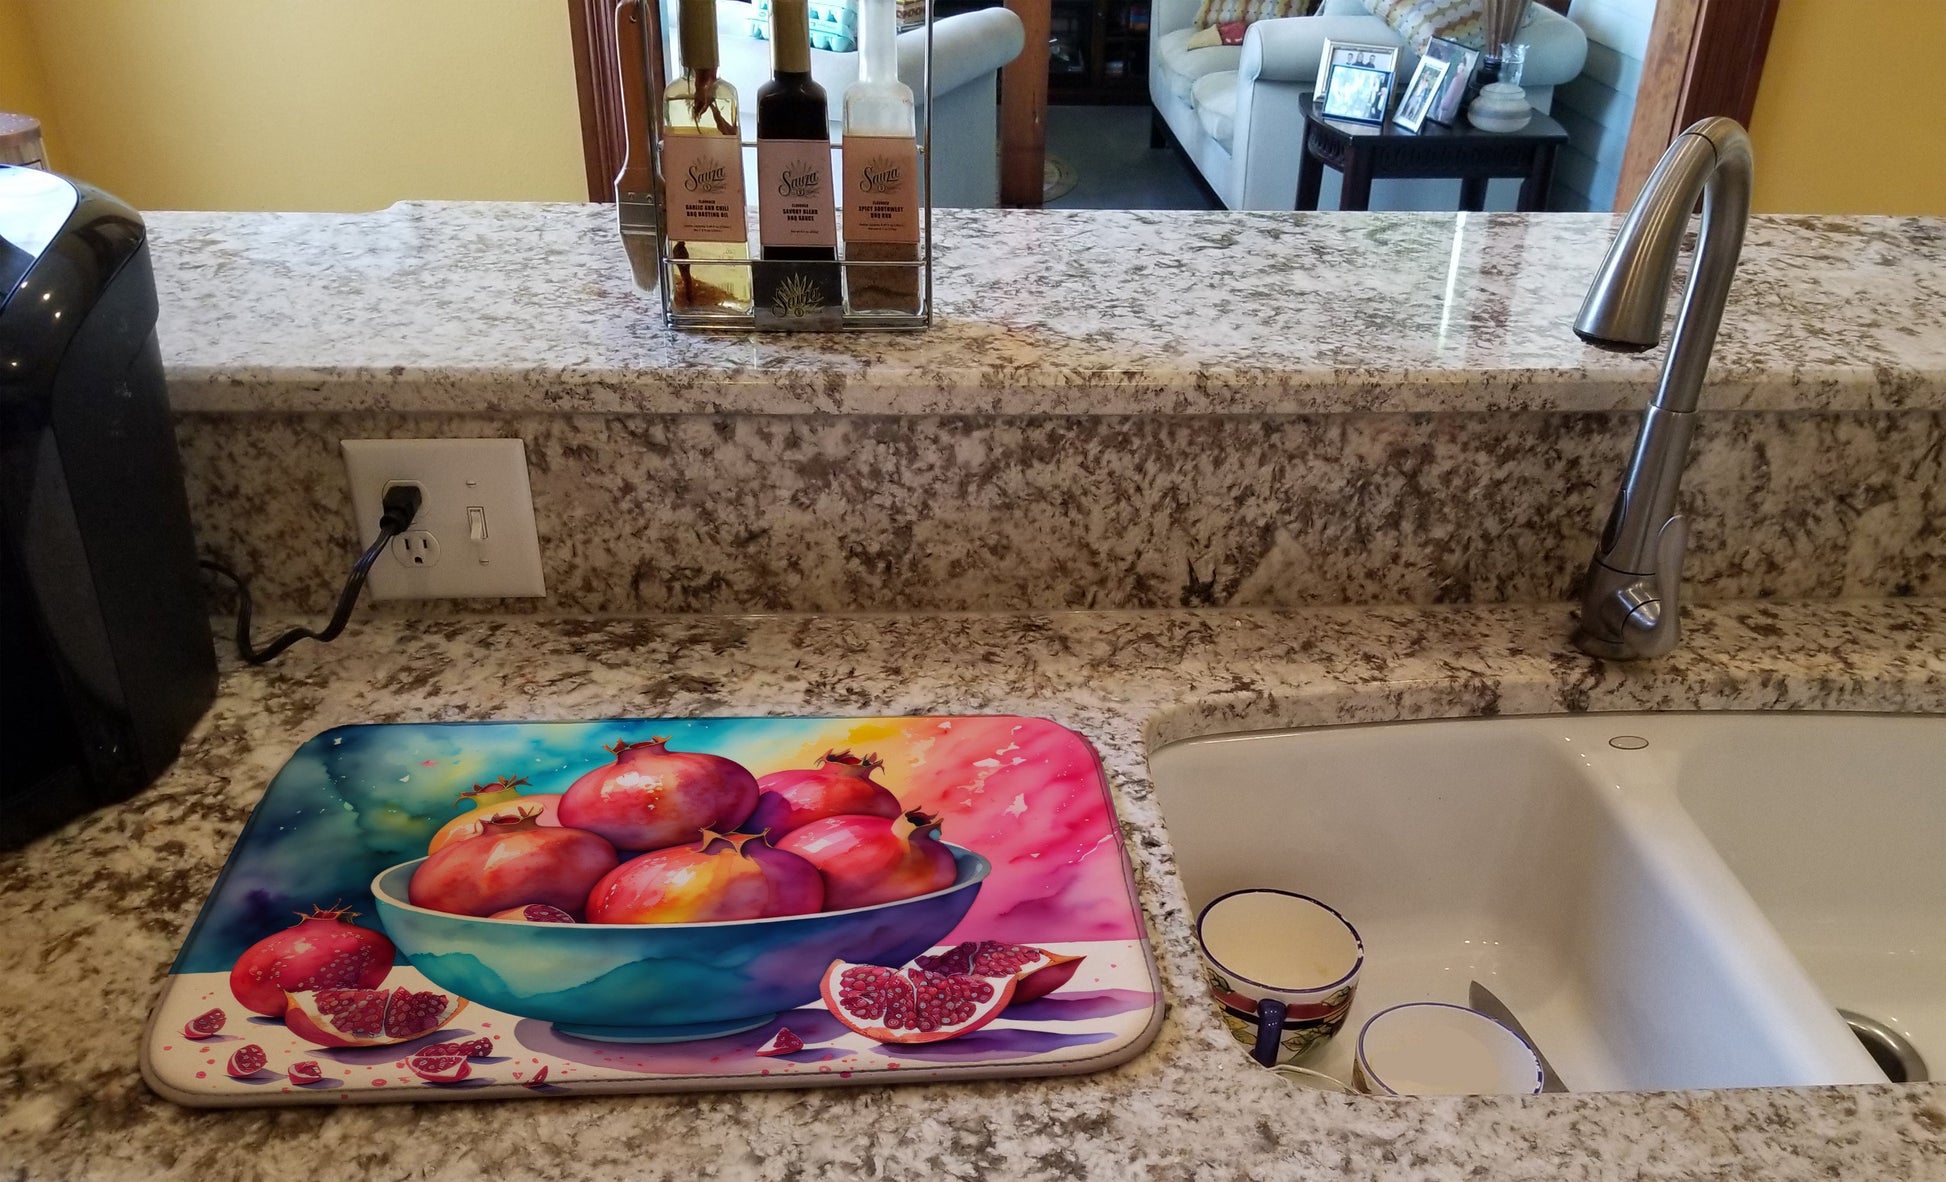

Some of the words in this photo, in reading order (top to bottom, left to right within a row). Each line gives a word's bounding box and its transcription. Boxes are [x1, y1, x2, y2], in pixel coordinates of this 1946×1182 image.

[685, 166, 726, 191] Sauza
[778, 171, 819, 197] Sauza
[860, 166, 900, 192] Sauza
[771, 287, 821, 318] Sauza
